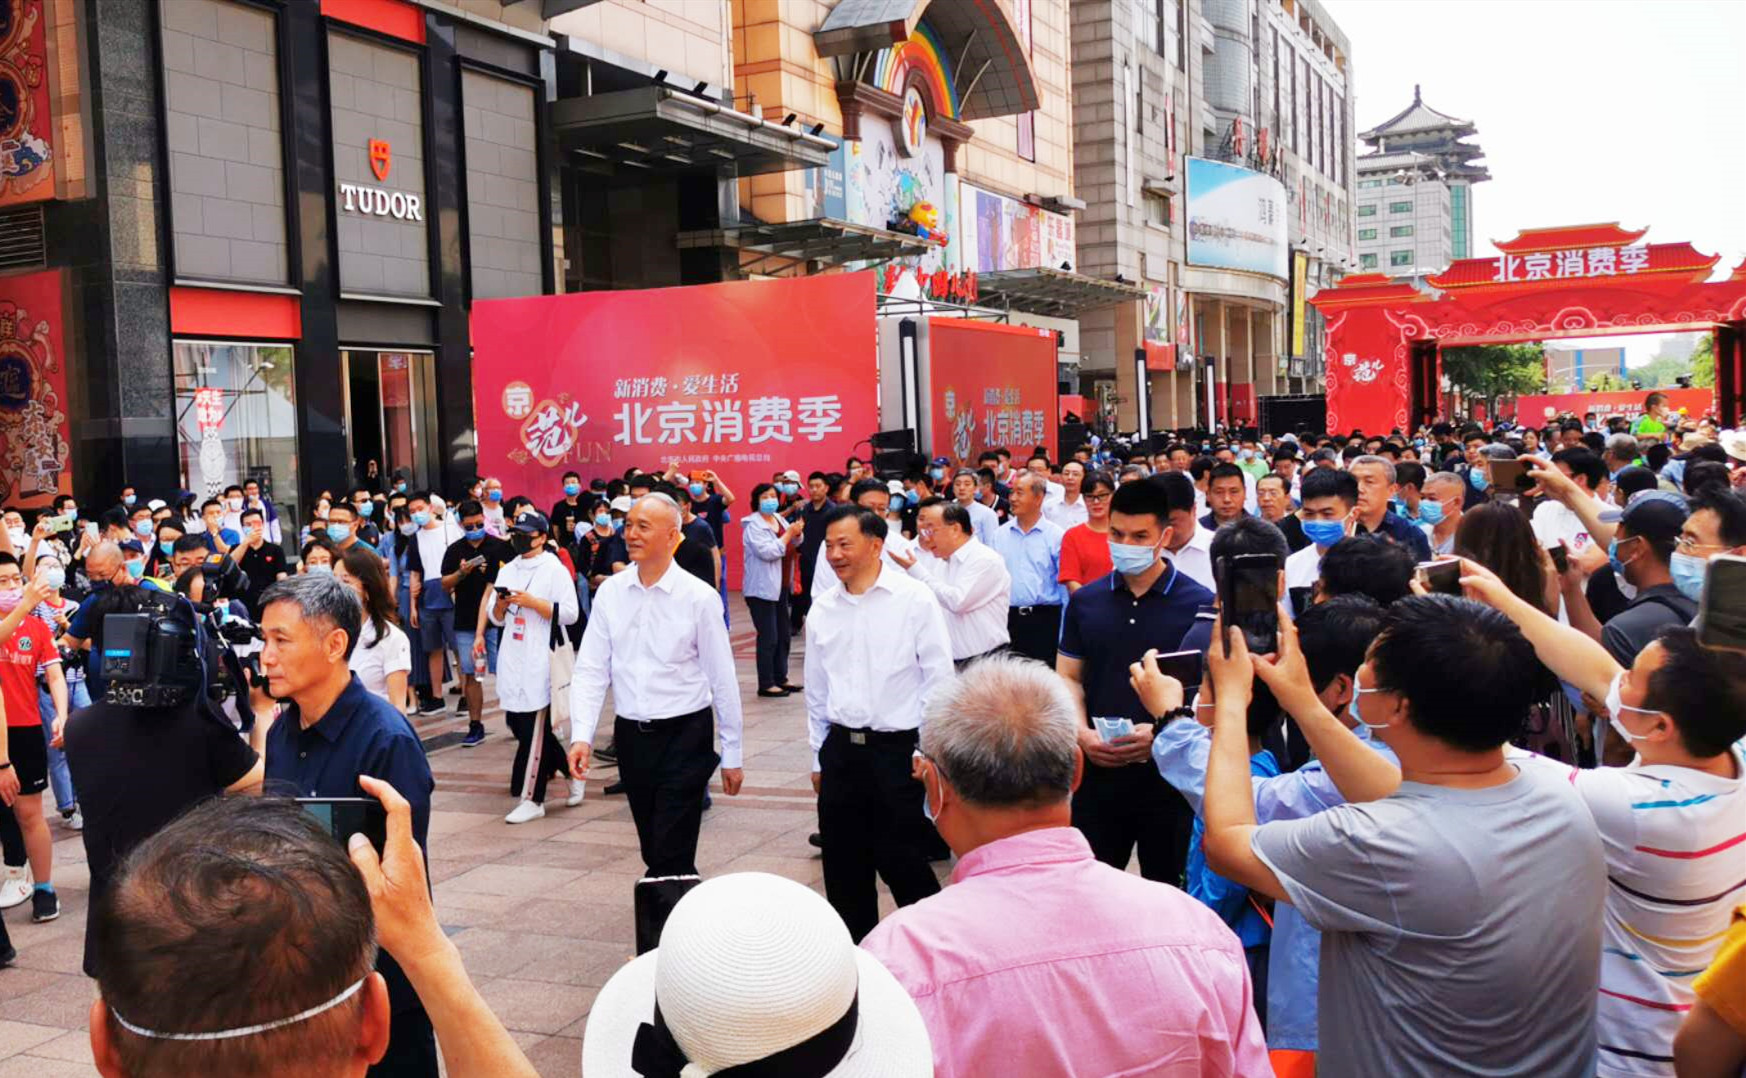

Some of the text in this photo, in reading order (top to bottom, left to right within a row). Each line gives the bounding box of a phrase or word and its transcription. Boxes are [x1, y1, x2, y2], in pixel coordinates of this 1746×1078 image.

[341, 184, 422, 221] TUDOR
[1493, 245, 1649, 283] 北京消费季
[505, 386, 531, 417] 京
[614, 373, 739, 398] 新消费·爱生活
[613, 395, 843, 445] 北京消费季
[984, 409, 1045, 448] 北京消费季
